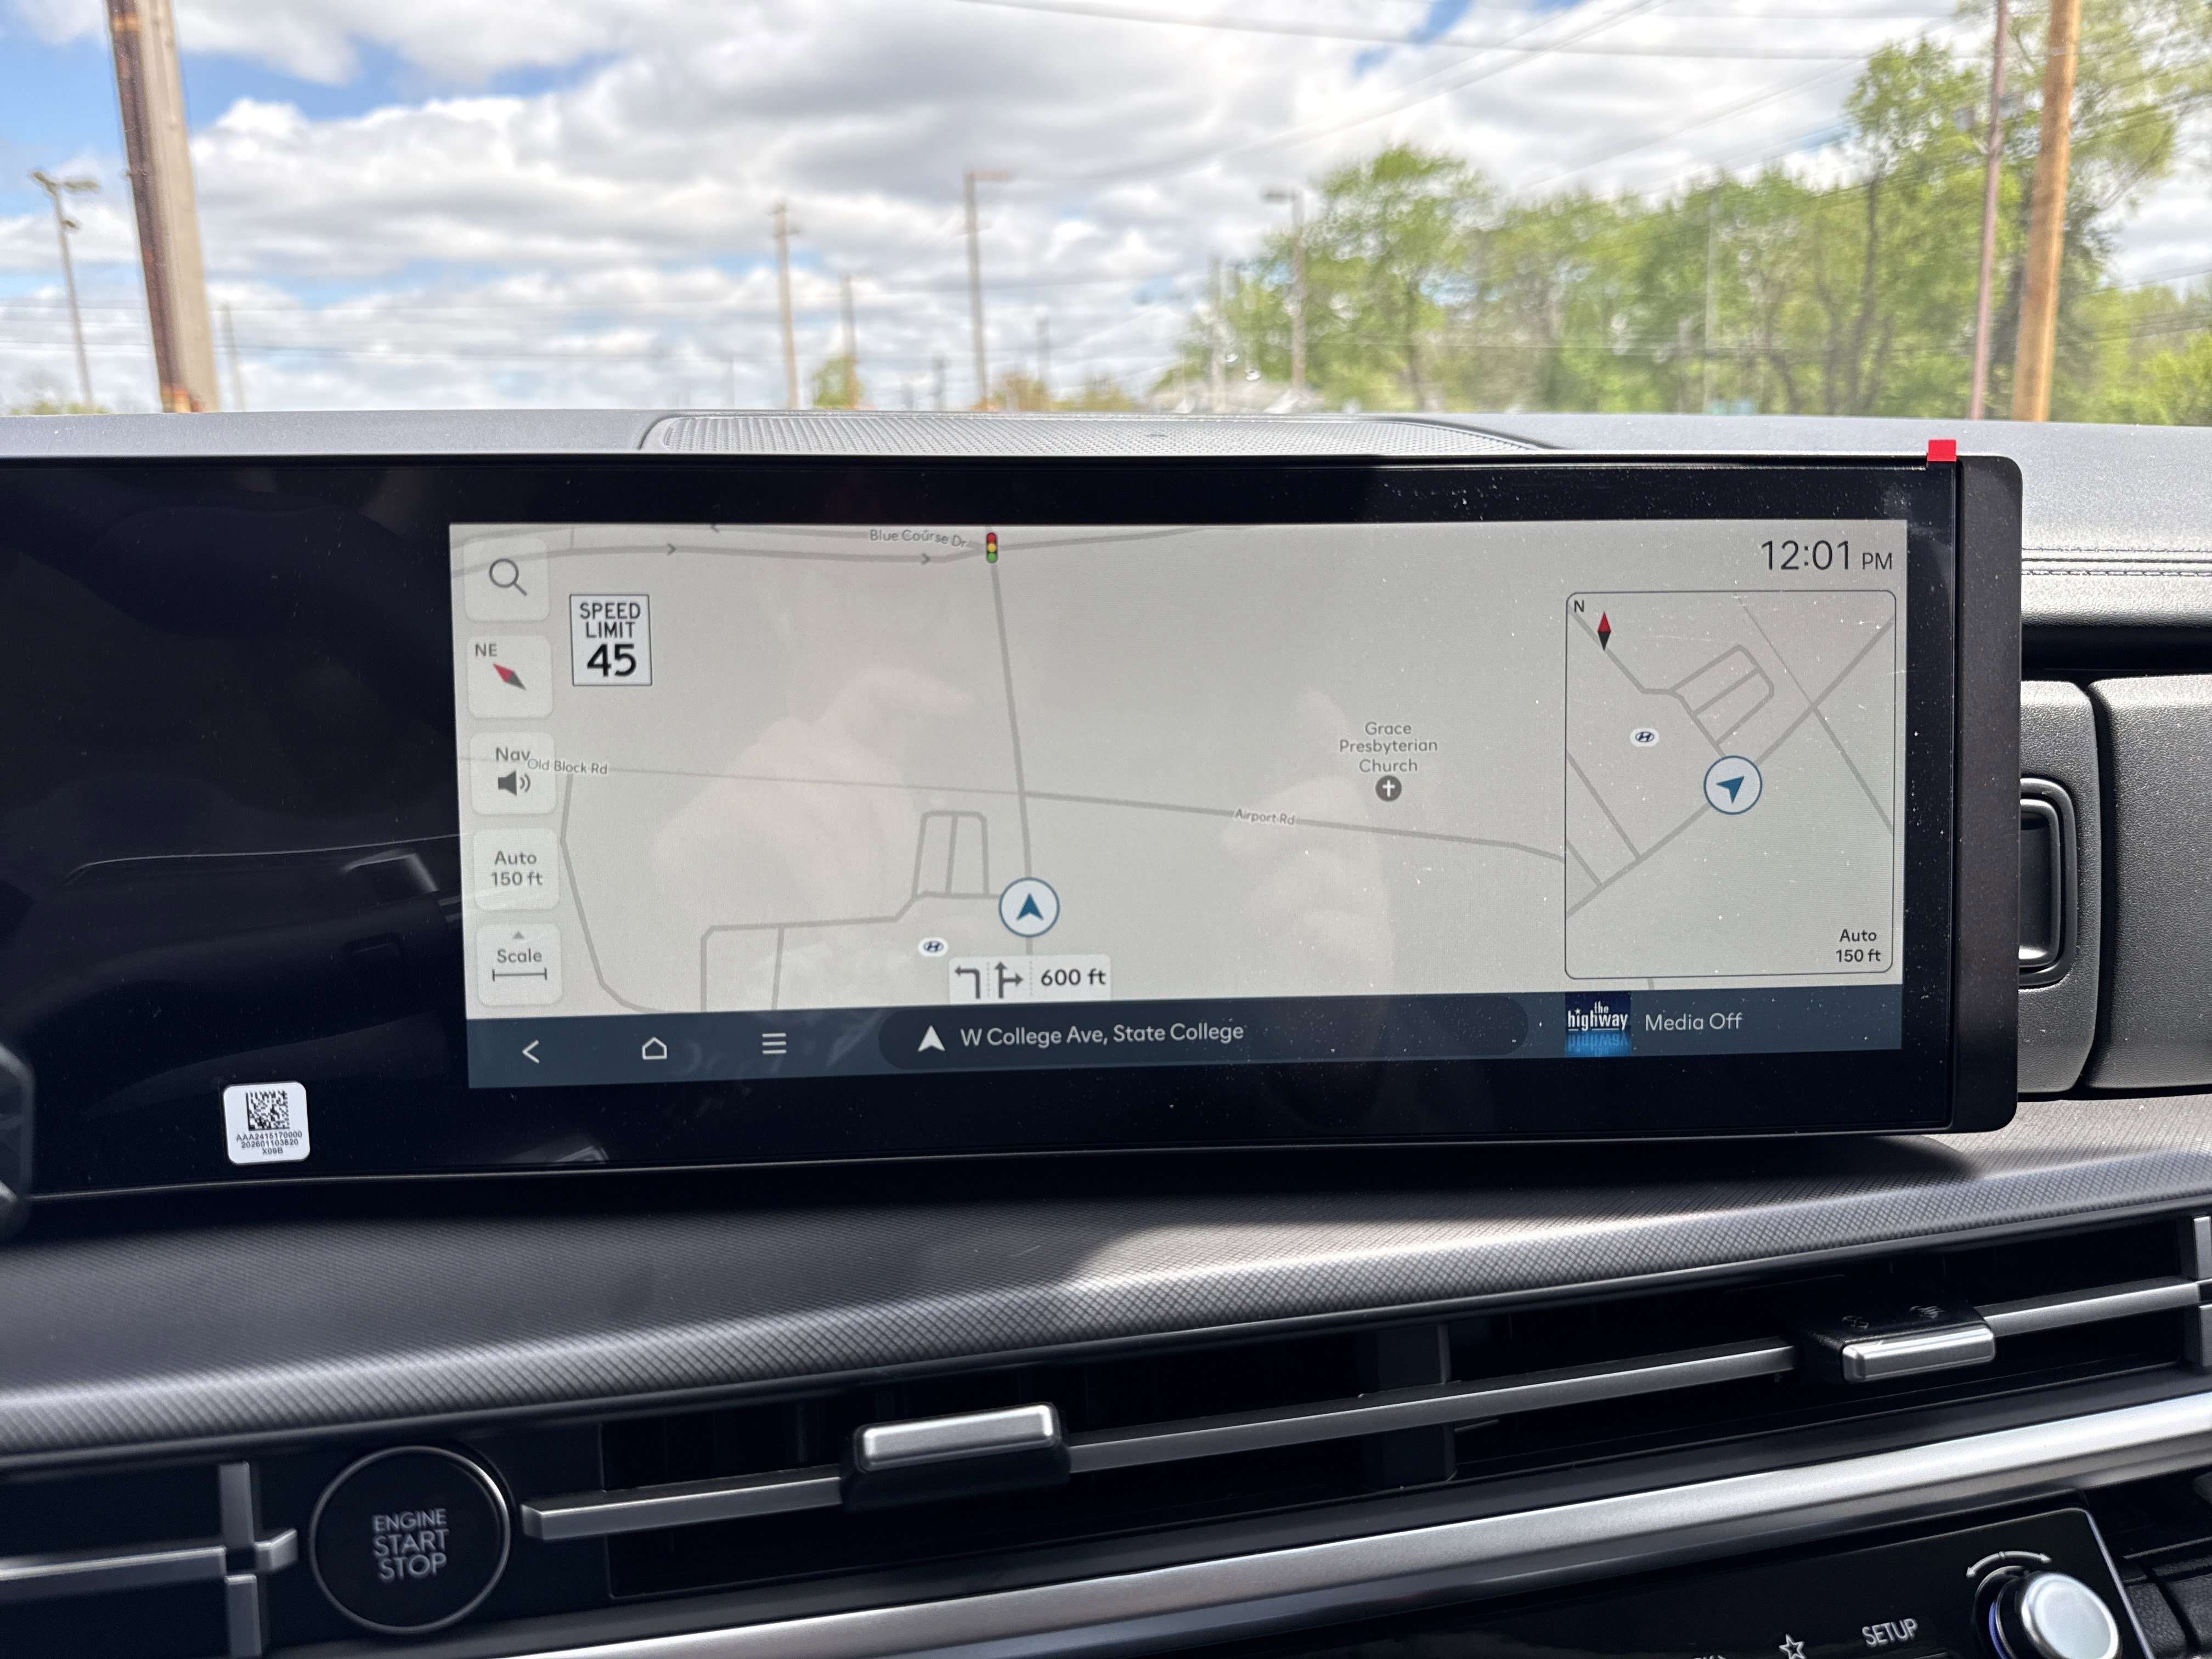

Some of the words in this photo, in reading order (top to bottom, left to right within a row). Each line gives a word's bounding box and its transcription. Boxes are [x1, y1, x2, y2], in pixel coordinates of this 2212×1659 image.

[870, 529, 899, 541] Blue
[901, 529, 949, 544] Course
[951, 534, 967, 548] Dr
[1761, 540, 1848, 571] 12:01
[1862, 552, 1892, 570] PM
[580, 602, 641, 620] SPEED
[1573, 600, 1585, 613] N
[585, 621, 636, 639] LIMIT
[475, 643, 497, 658] NE
[586, 643, 637, 677] 45
[1364, 721, 1412, 735] Grace
[495, 748, 531, 761] Nav
[1339, 738, 1438, 755] Presbyterian
[528, 758, 550, 771] Old
[554, 761, 588, 774] Block
[591, 763, 608, 775] Rd
[1359, 759, 1418, 773] Church
[1235, 808, 1277, 825] Airport
[1279, 813, 1296, 826] Rd
[494, 850, 537, 866] Auto
[491, 872, 523, 887] 150
[526, 871, 543, 886] ft
[1839, 928, 1877, 943] Auto
[496, 949, 543, 963] Scale
[1835, 949, 1864, 963] 150
[1867, 949, 1881, 963] ft
[1040, 968, 1081, 986] 600
[1088, 968, 1107, 986] ft
[1594, 1001, 1609, 1014] the
[1567, 1009, 1628, 1031] highway
[1645, 1013, 1704, 1031] Media
[1709, 1012, 1743, 1030] Off
[960, 1028, 982, 1047] W
[987, 1026, 1062, 1048] College
[1066, 1025, 1108, 1046] Ave,
[1113, 1024, 1166, 1043] State
[1170, 1022, 1245, 1045] College
[373, 1508, 448, 1533] ENGINE
[373, 1528, 450, 1558] START
[379, 1552, 447, 1583] STOP
[1861, 1618, 1918, 1647] SETUP
